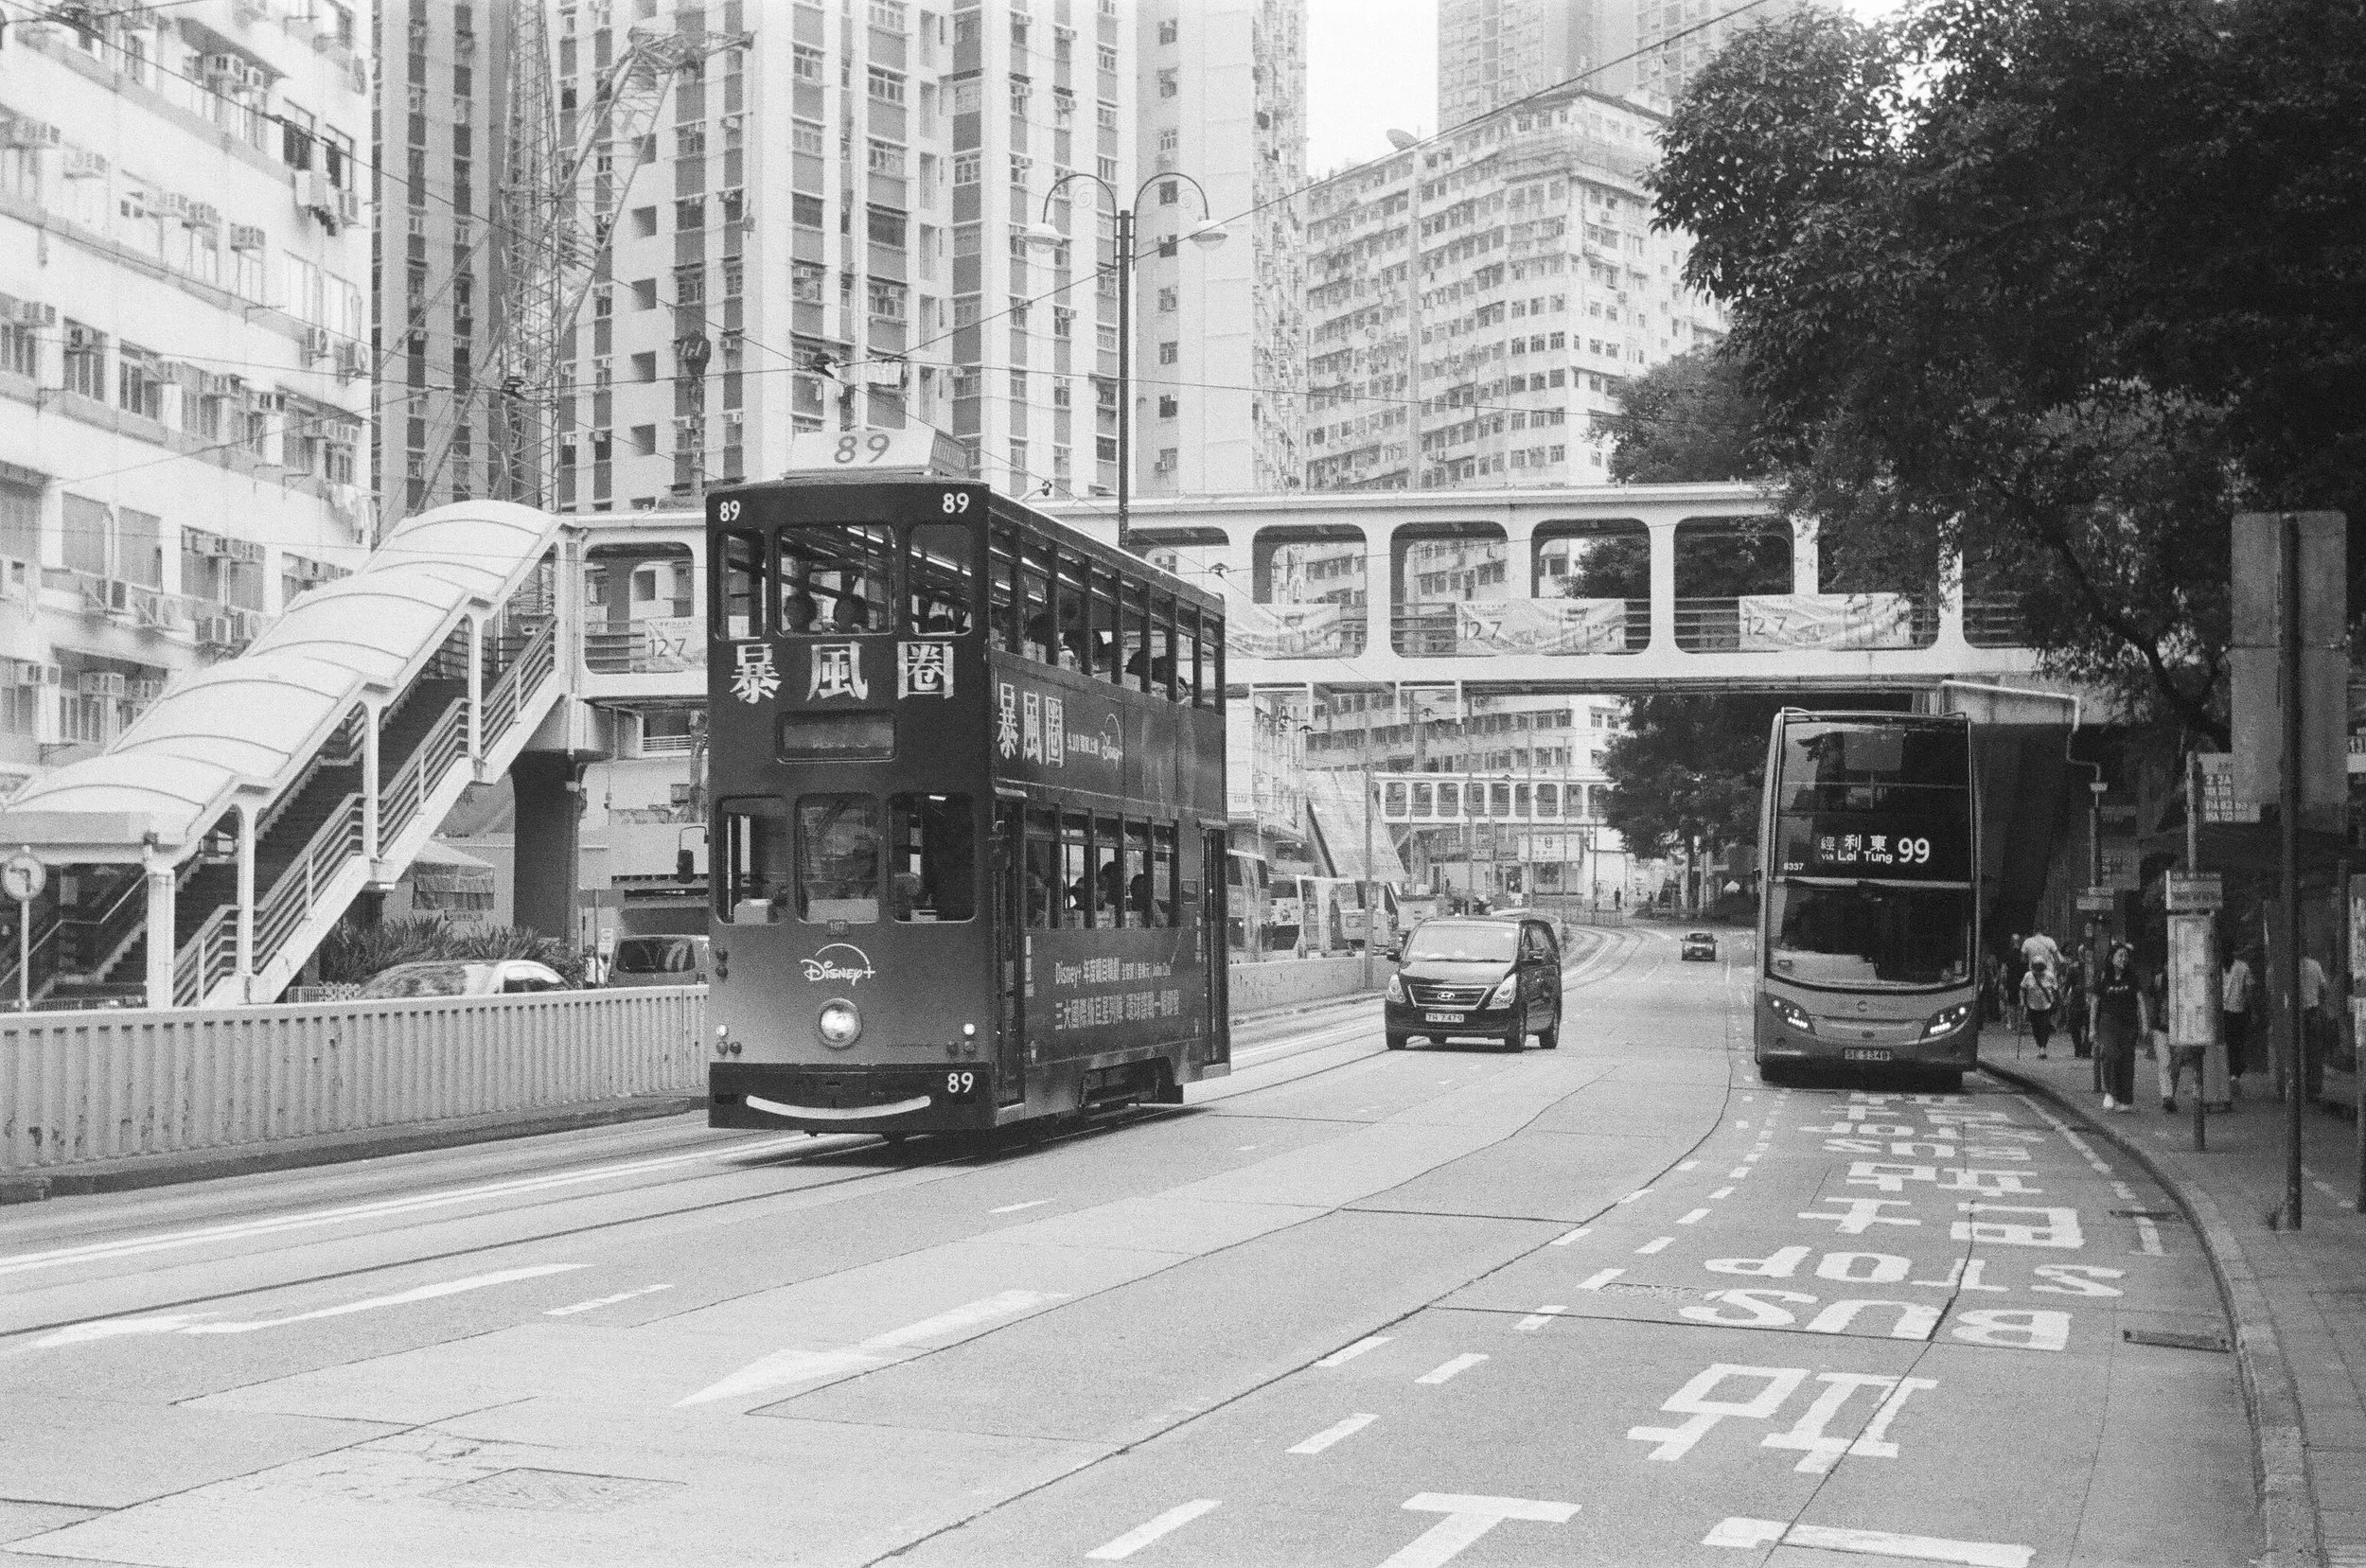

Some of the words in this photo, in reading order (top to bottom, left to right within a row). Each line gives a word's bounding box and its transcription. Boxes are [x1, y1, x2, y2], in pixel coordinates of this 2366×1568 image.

[834, 433, 891, 465] 89
[718, 500, 741, 521] 89
[943, 492, 969, 514] 89
[730, 642, 955, 705] 暴風圈
[997, 682, 1064, 768] 暴風圈
[1838, 849, 1857, 862] Lei
[1863, 850, 1893, 865] Tung
[1898, 837, 1930, 863] 99
[801, 960, 875, 986] Disney+
[947, 1071, 974, 1094] 89
[1845, 1161, 2042, 1197] 站
[1797, 1196, 2084, 1249] 巴士
[1704, 1245, 2125, 1297] STOP
[1678, 1288, 2073, 1352] BUS
[1627, 1363, 1939, 1474] 站
